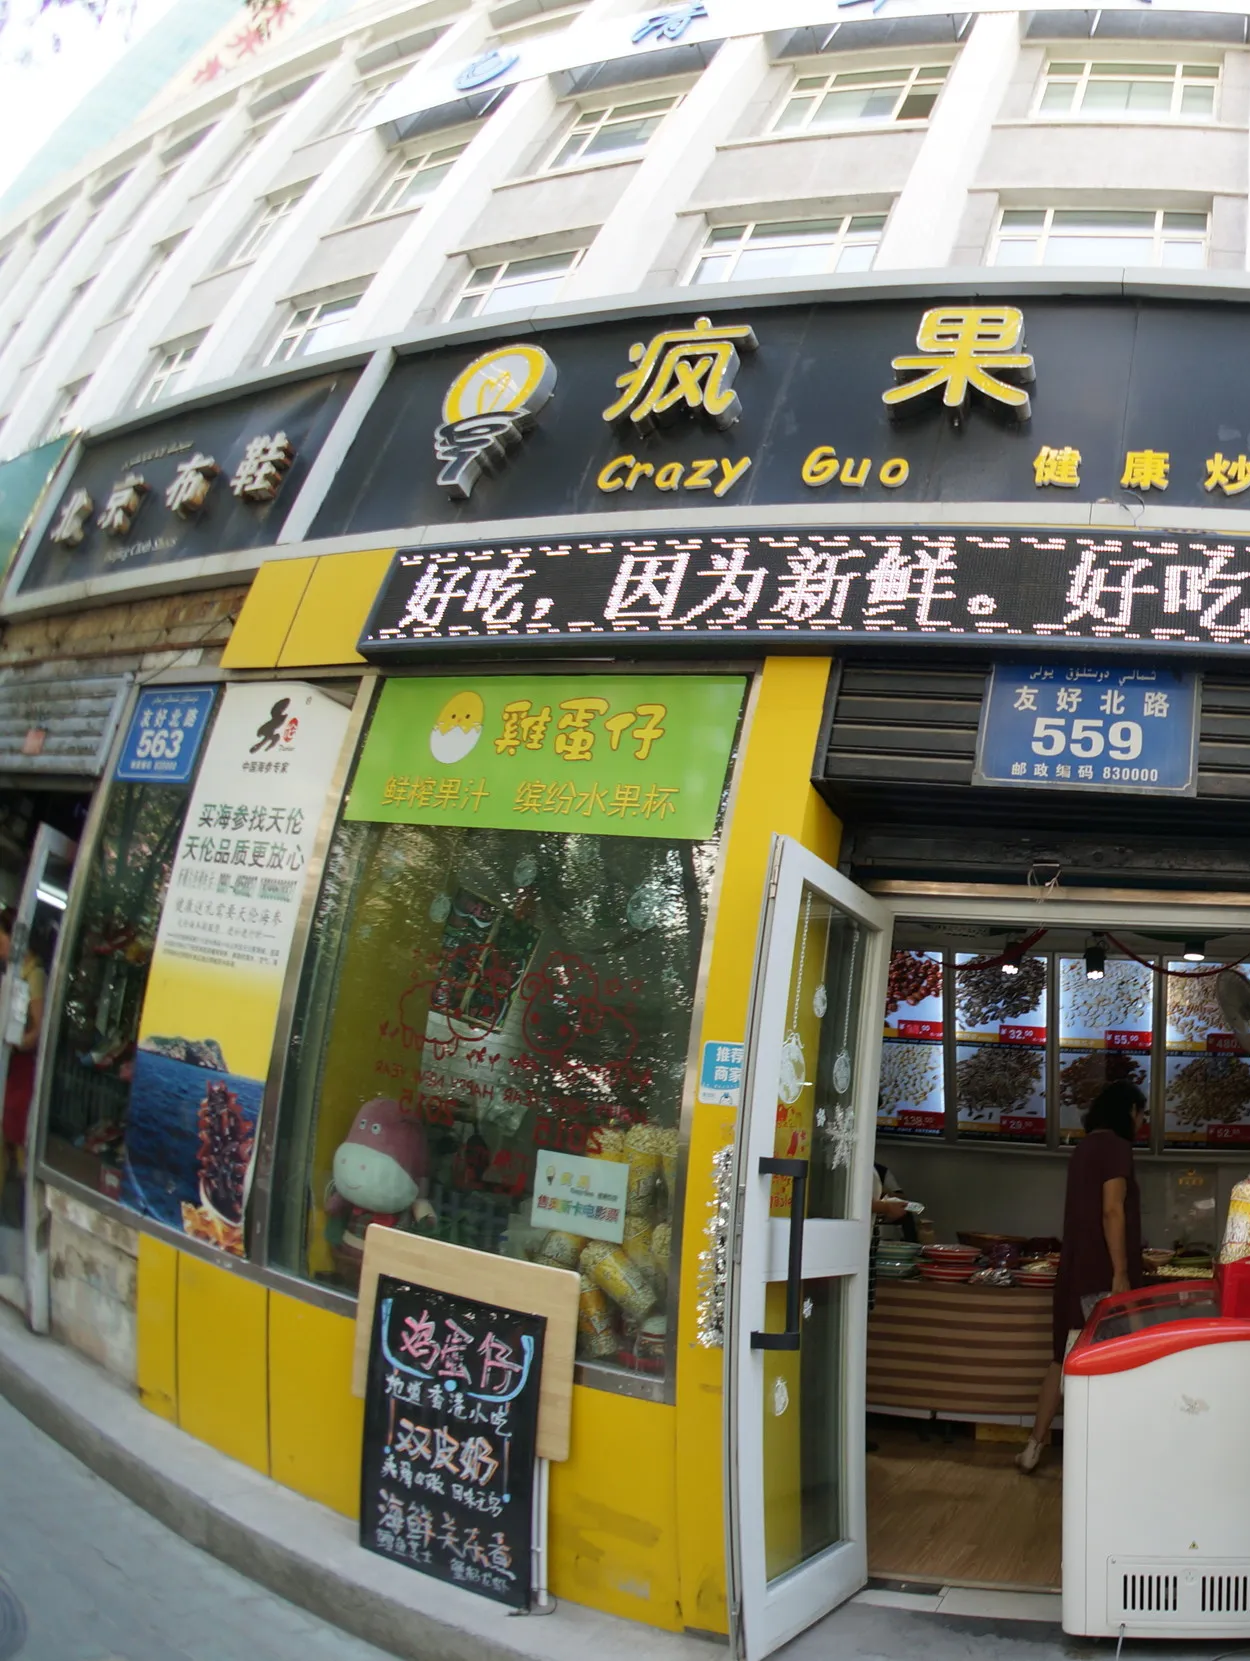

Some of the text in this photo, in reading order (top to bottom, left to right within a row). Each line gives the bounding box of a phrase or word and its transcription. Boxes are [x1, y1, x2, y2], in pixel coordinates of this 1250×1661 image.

[597, 445, 910, 497] Crazy Guo
[1013, 685, 1170, 718] 友好北路
[136, 729, 185, 758] 563
[1031, 717, 1143, 761] 559
[1011, 762, 1158, 782] 邮政编码 830000
[380, 775, 680, 821] 鲜榨果汁 缤纷水果杯
[198, 803, 305, 835] 买海参找天伦
[182, 835, 305, 871] 天伦品质更放心
[714, 1065, 743, 1082] 商家
[716, 1046, 744, 1063] 推荐
[400, 1310, 524, 1394] 鸡蛋仔
[385, 1373, 513, 1438] 地道香港小吃
[394, 1417, 499, 1487] 双皮奶
[377, 1488, 517, 1581] 海鲜关东煮
